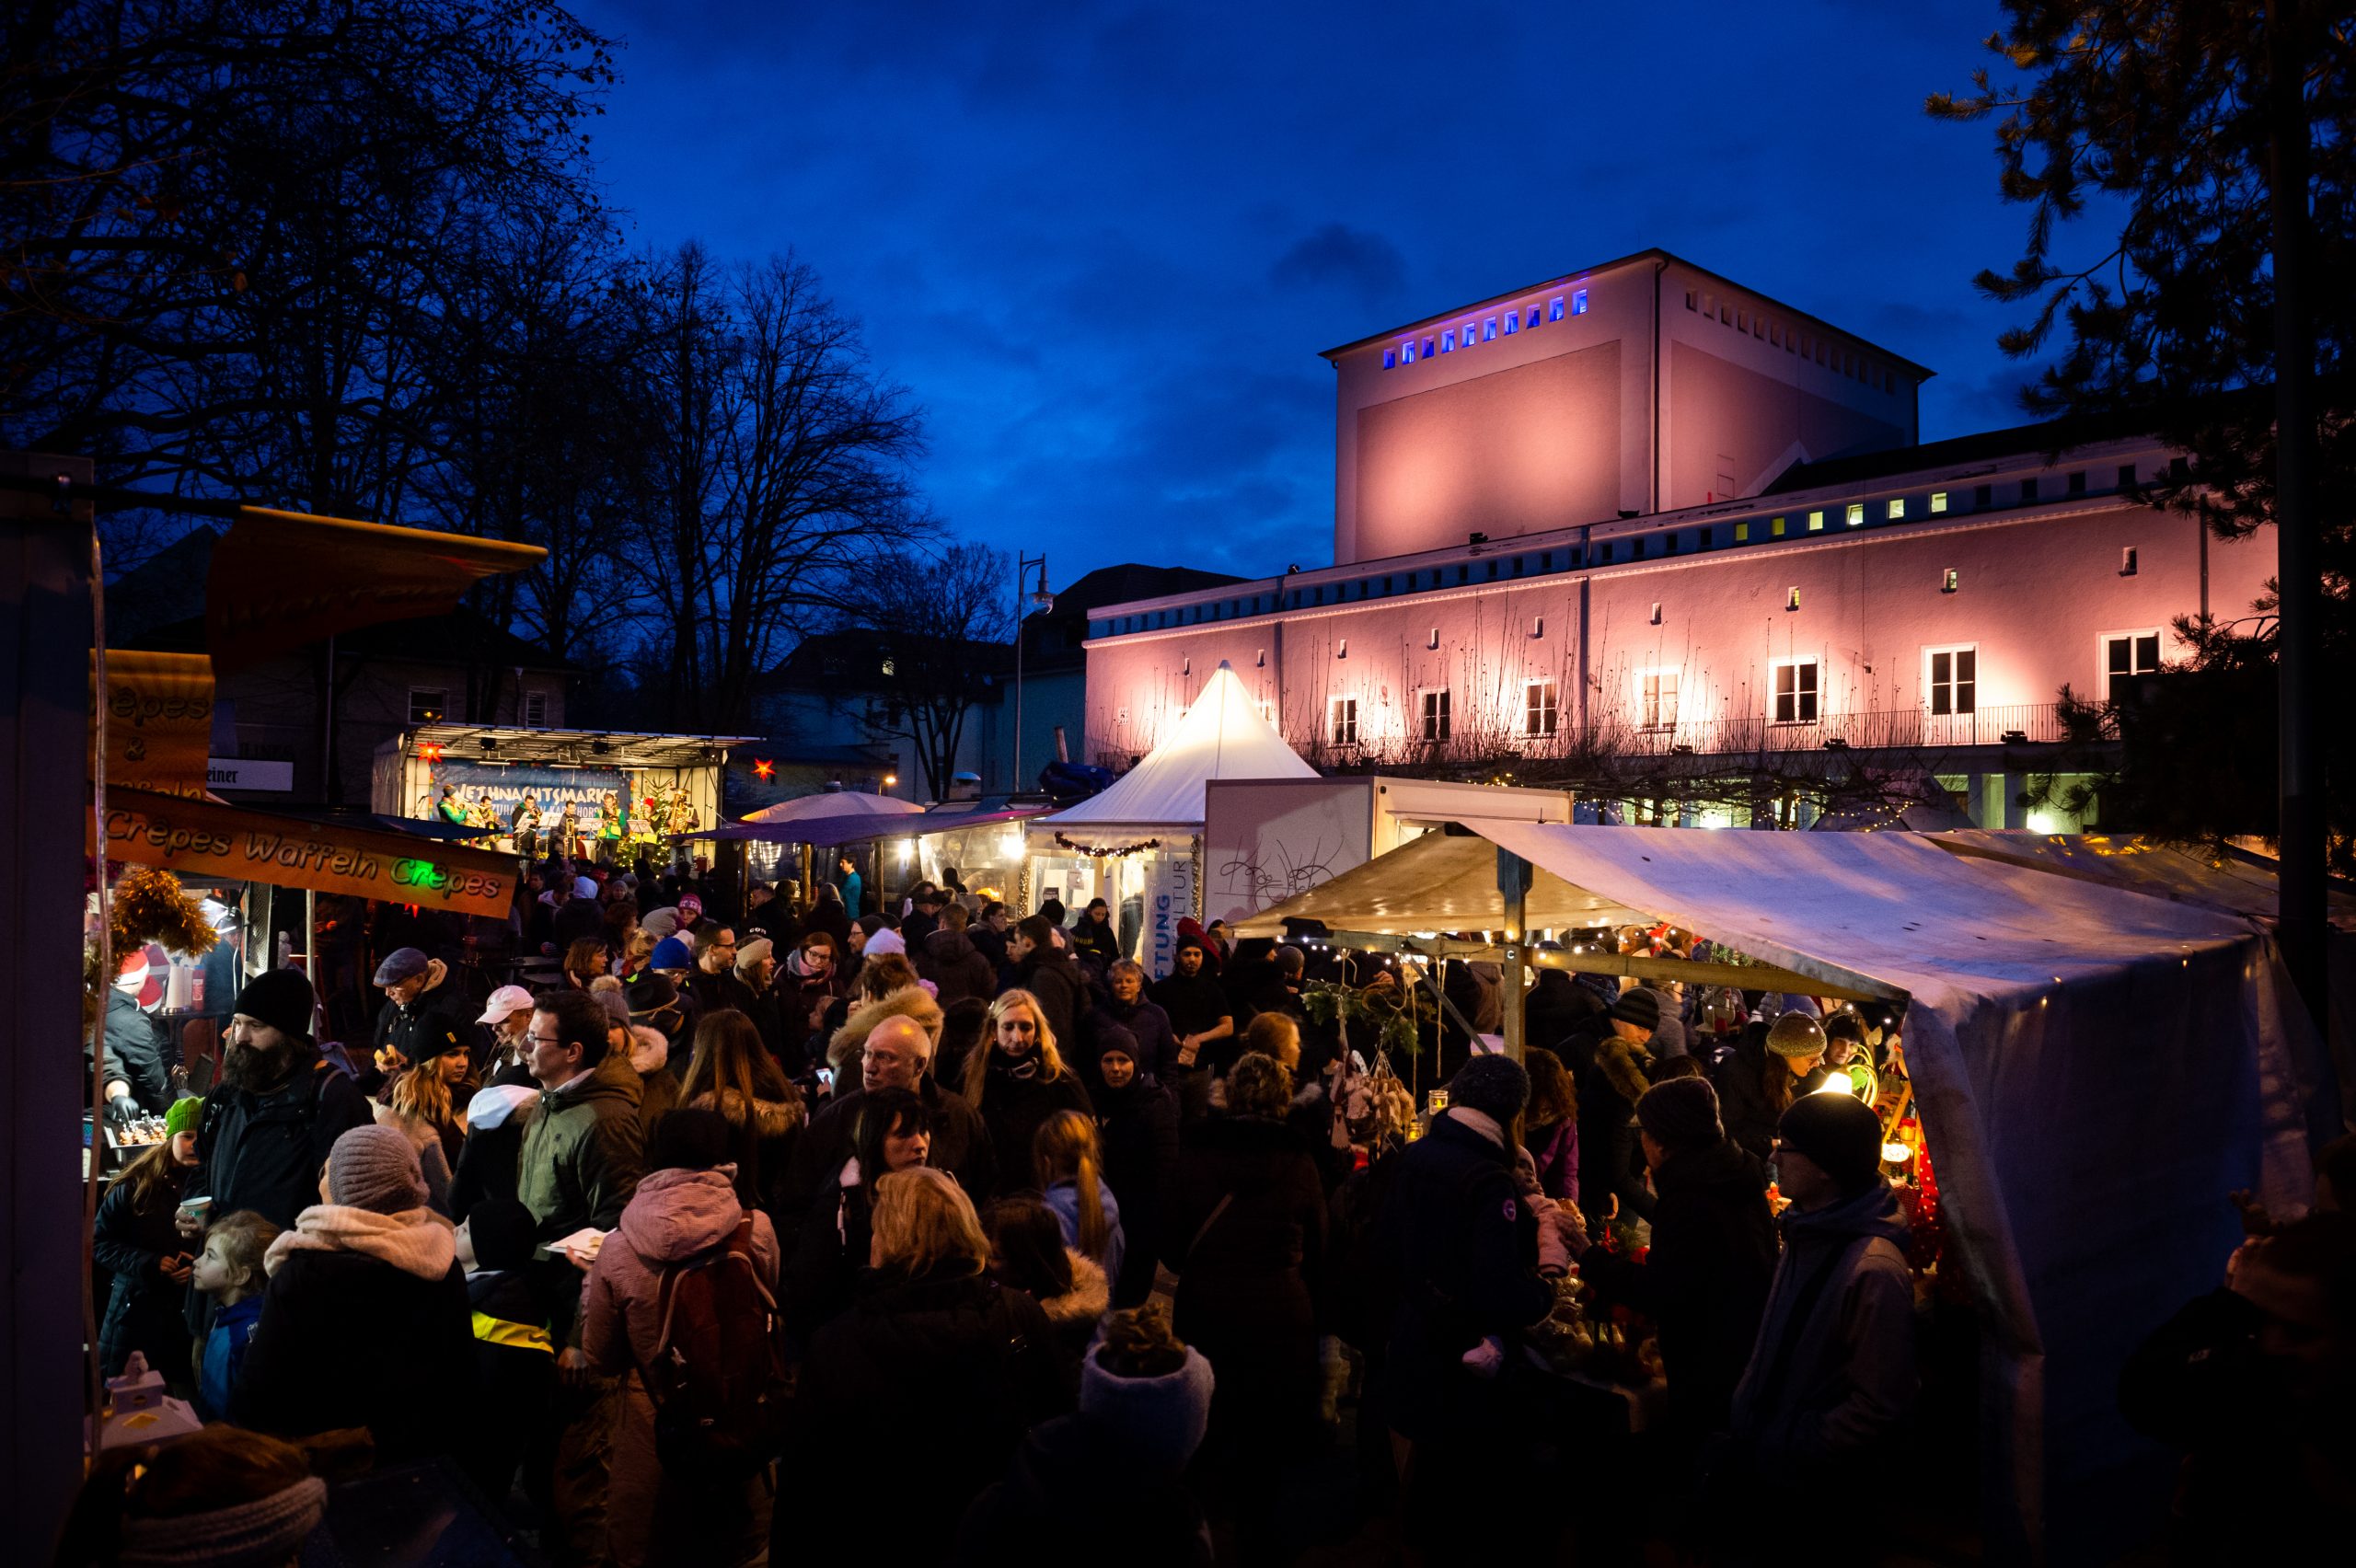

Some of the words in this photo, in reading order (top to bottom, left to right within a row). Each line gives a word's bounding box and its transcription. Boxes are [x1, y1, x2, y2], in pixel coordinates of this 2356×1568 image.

[123, 736, 146, 762] &
[205, 767, 239, 784] einer
[106, 808, 233, 858] Crêpes
[244, 830, 378, 881] Waffeln
[390, 856, 501, 899] Crêpes
[1154, 894, 1170, 980] FTUNG
